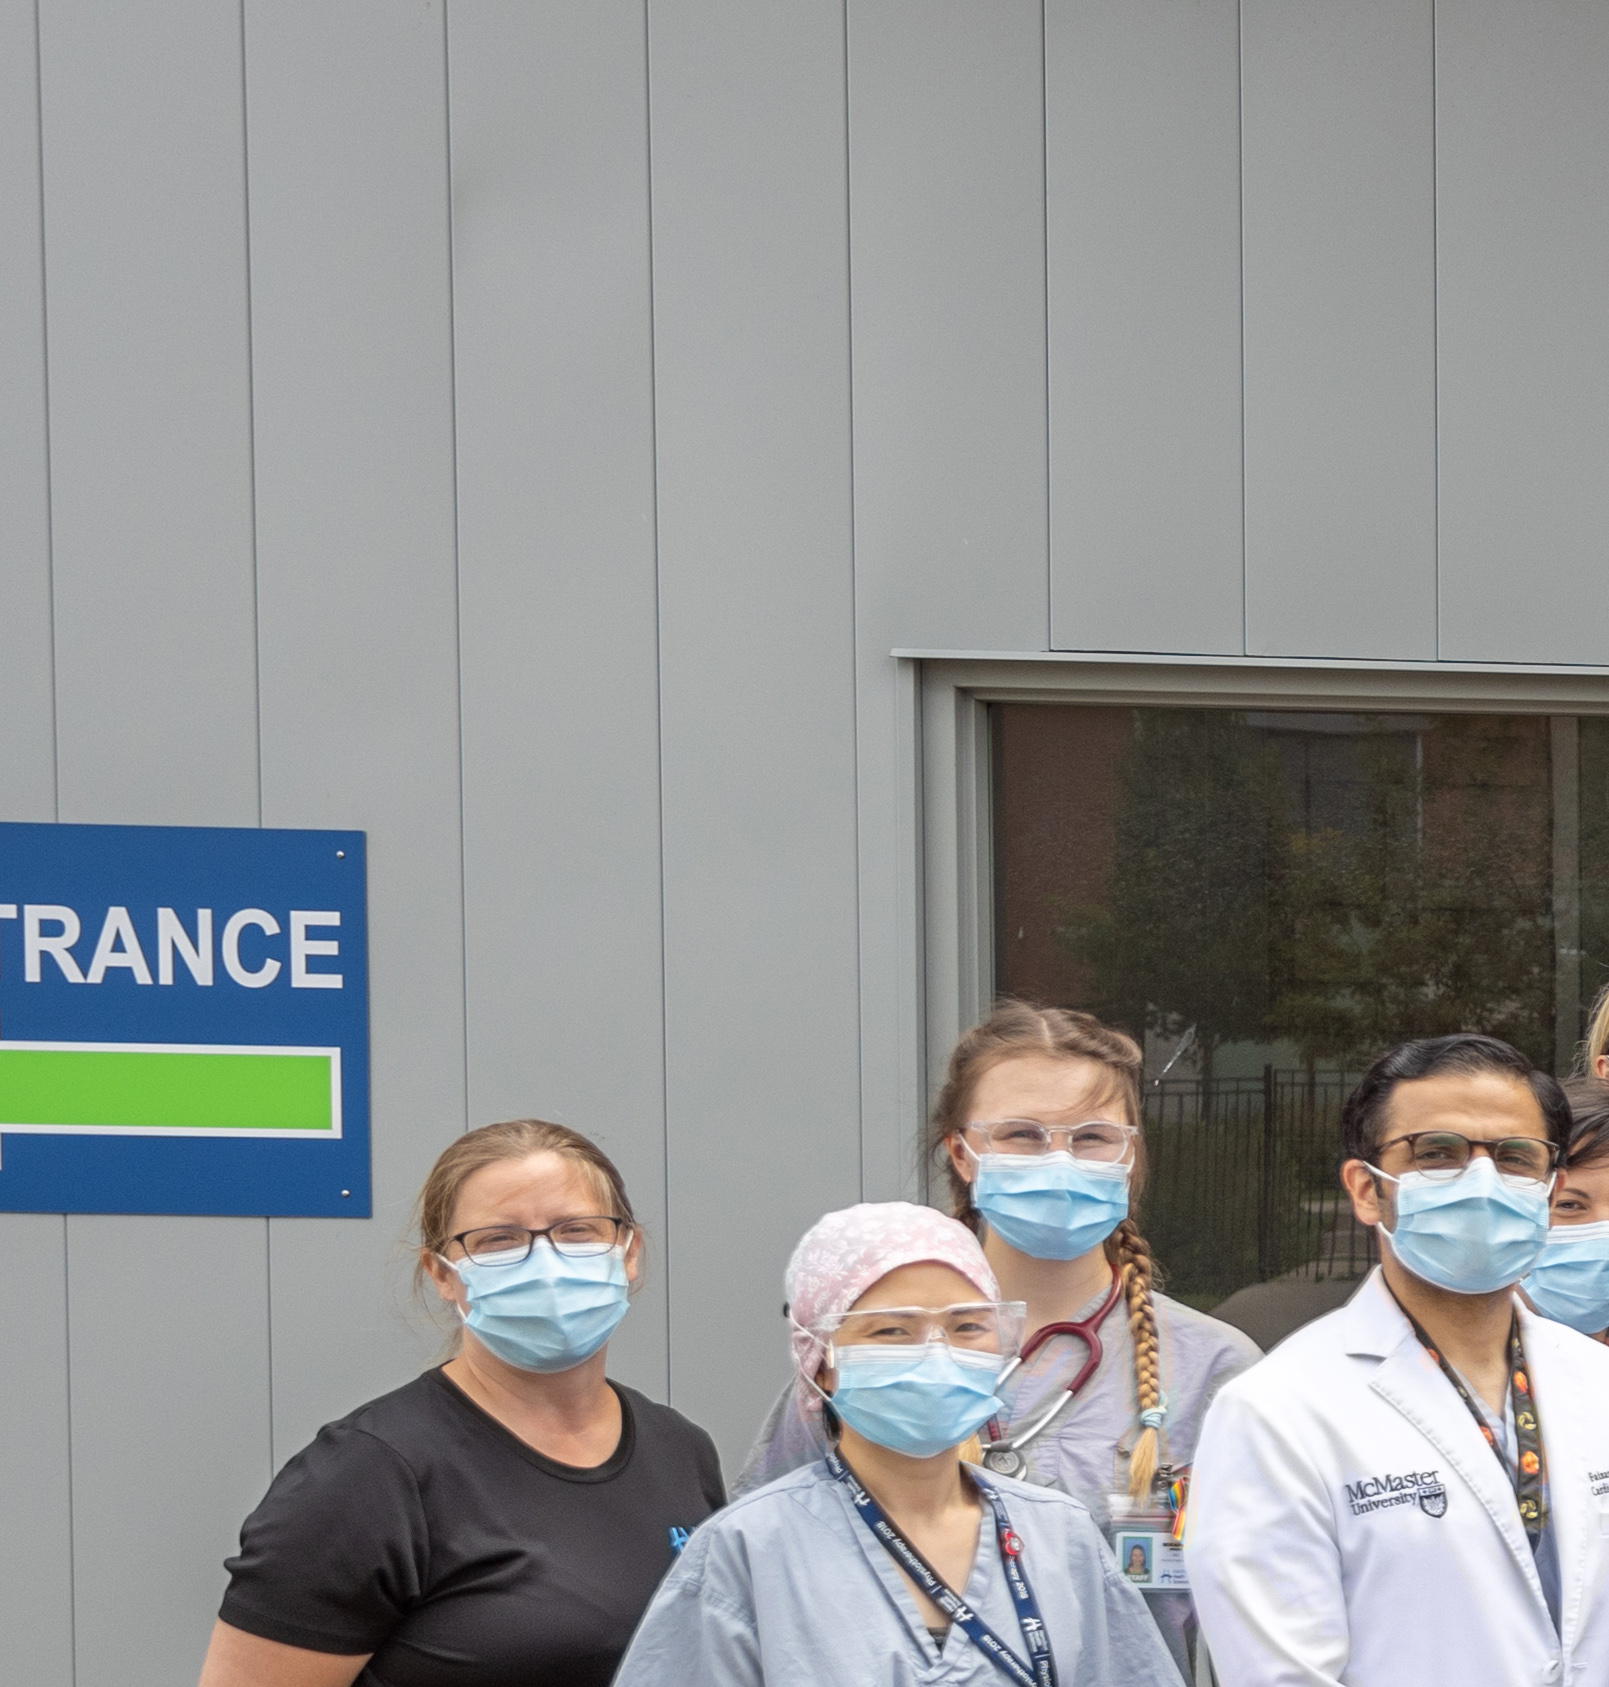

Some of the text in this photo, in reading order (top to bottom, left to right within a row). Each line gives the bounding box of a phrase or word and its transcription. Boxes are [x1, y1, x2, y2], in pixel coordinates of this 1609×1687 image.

[1345, 1470, 1440, 1504] McMaster
[1350, 1491, 1418, 1516] University
[877, 1520, 936, 1588] Physiotherapy 2018
[1015, 1581, 1029, 1599] 2018
[982, 1634, 1002, 1652] 2018
